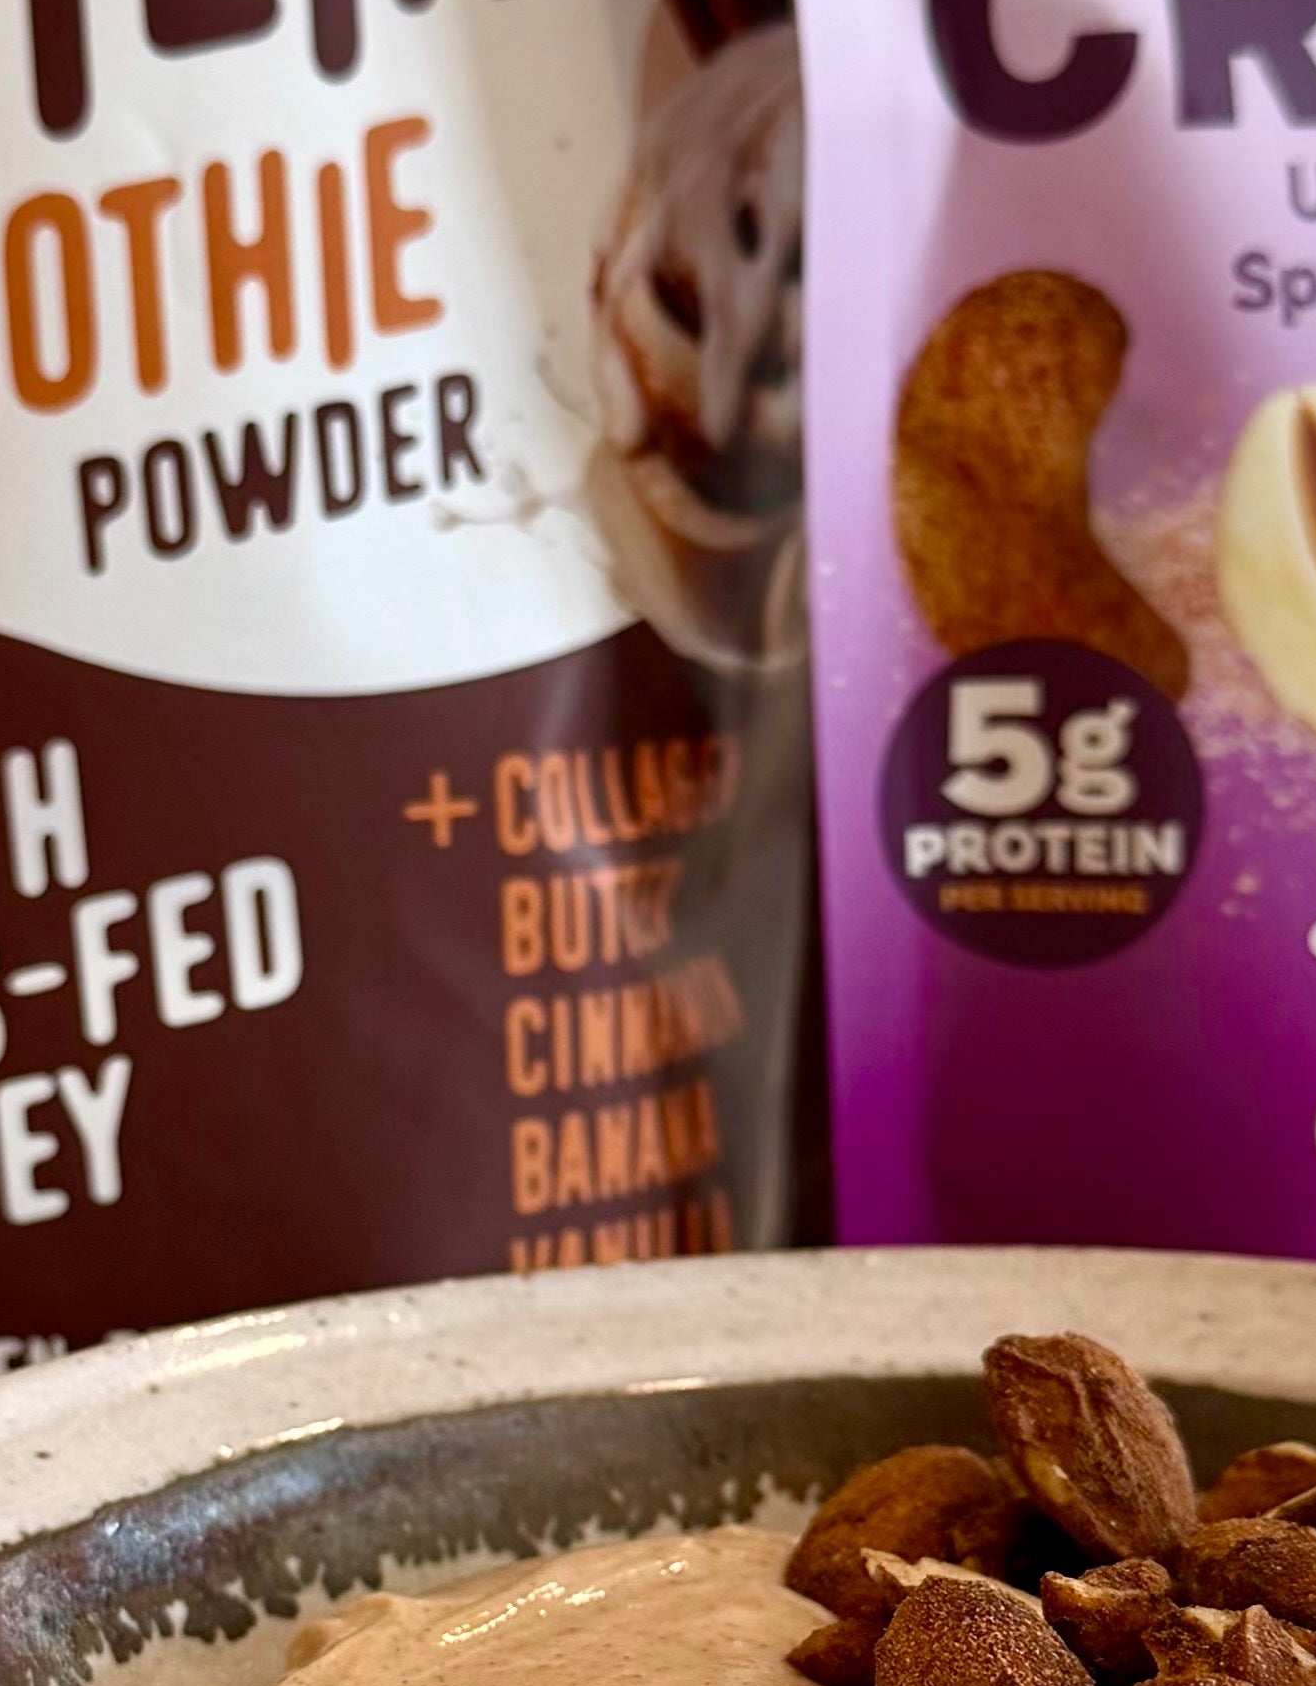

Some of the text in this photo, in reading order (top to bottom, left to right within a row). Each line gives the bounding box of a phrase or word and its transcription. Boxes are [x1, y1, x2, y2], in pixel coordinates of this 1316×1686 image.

[78, 372, 486, 578] POWDER
[939, 676, 1138, 816] 5g
[903, 819, 1183, 879] PROTEIN
